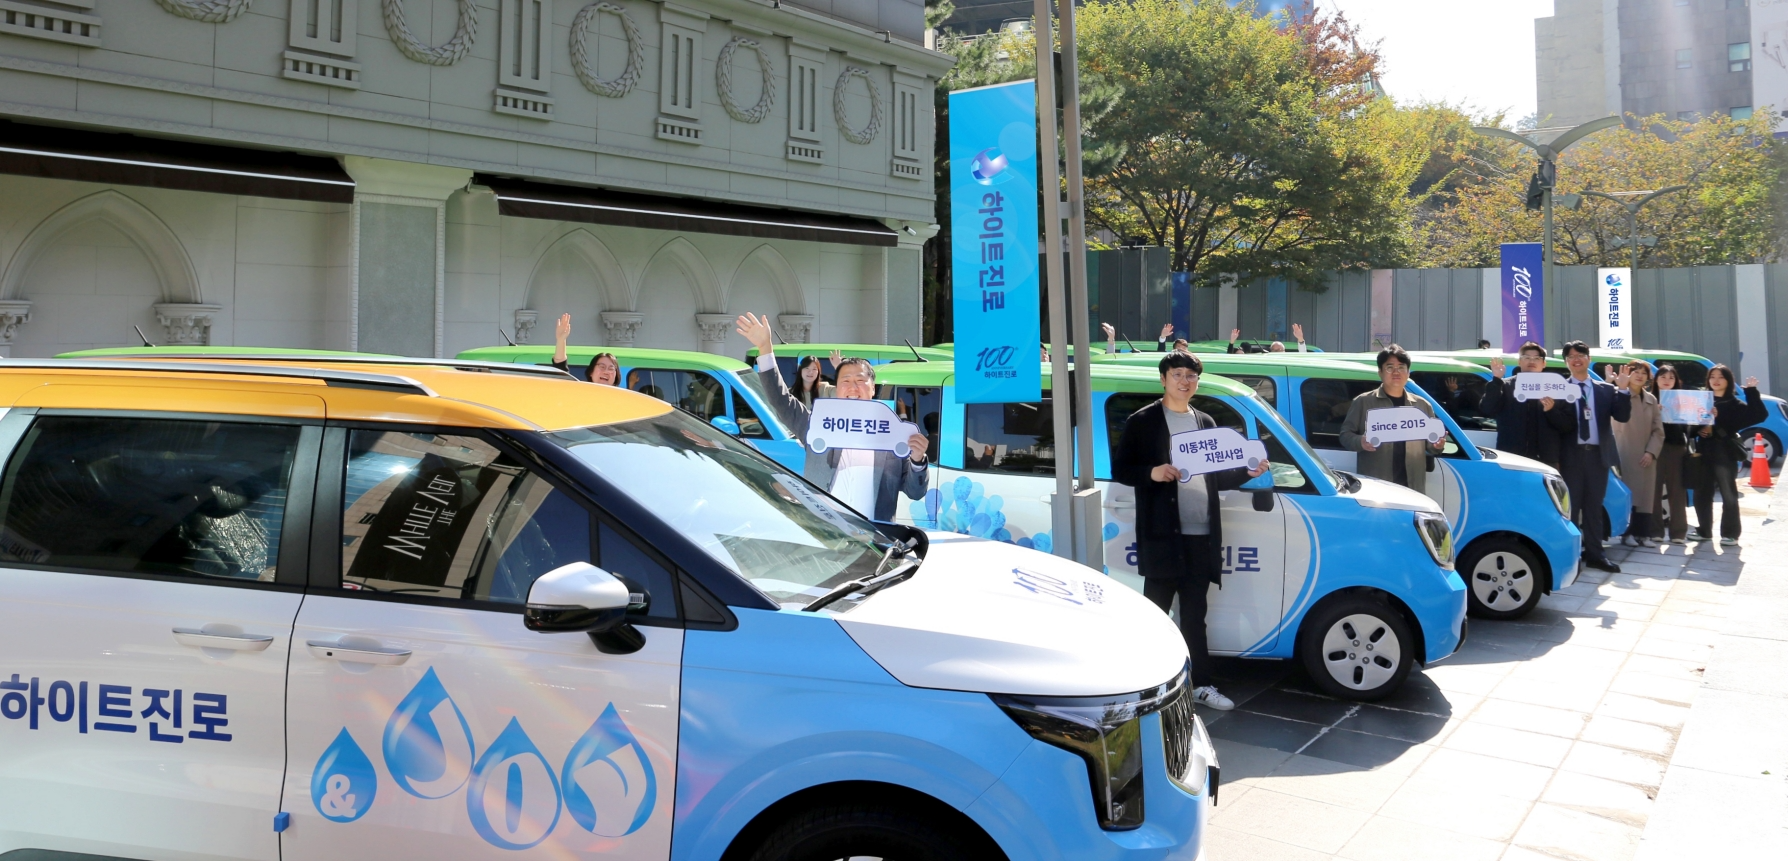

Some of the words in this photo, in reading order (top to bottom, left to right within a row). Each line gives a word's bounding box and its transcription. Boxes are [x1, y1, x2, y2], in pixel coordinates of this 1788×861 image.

[978, 190, 1005, 313] 하이트진로
[1511, 265, 1532, 299] 100
[1518, 300, 1528, 338] 하이트진로
[1608, 288, 1620, 328] 하이트진로
[1607, 338, 1623, 348] 100
[975, 345, 1015, 372] 100
[984, 370, 1018, 379] 하이트진로
[1521, 383, 1541, 391] 진심을
[822, 416, 891, 435] 하이트진로
[1371, 422, 1398, 432] since
[1400, 419, 1426, 429] 2015
[1179, 438, 1218, 454] 이동차량
[1204, 447, 1244, 463] 지원사업
[0, 673, 233, 744] 하이트진로
[319, 773, 357, 819] &
